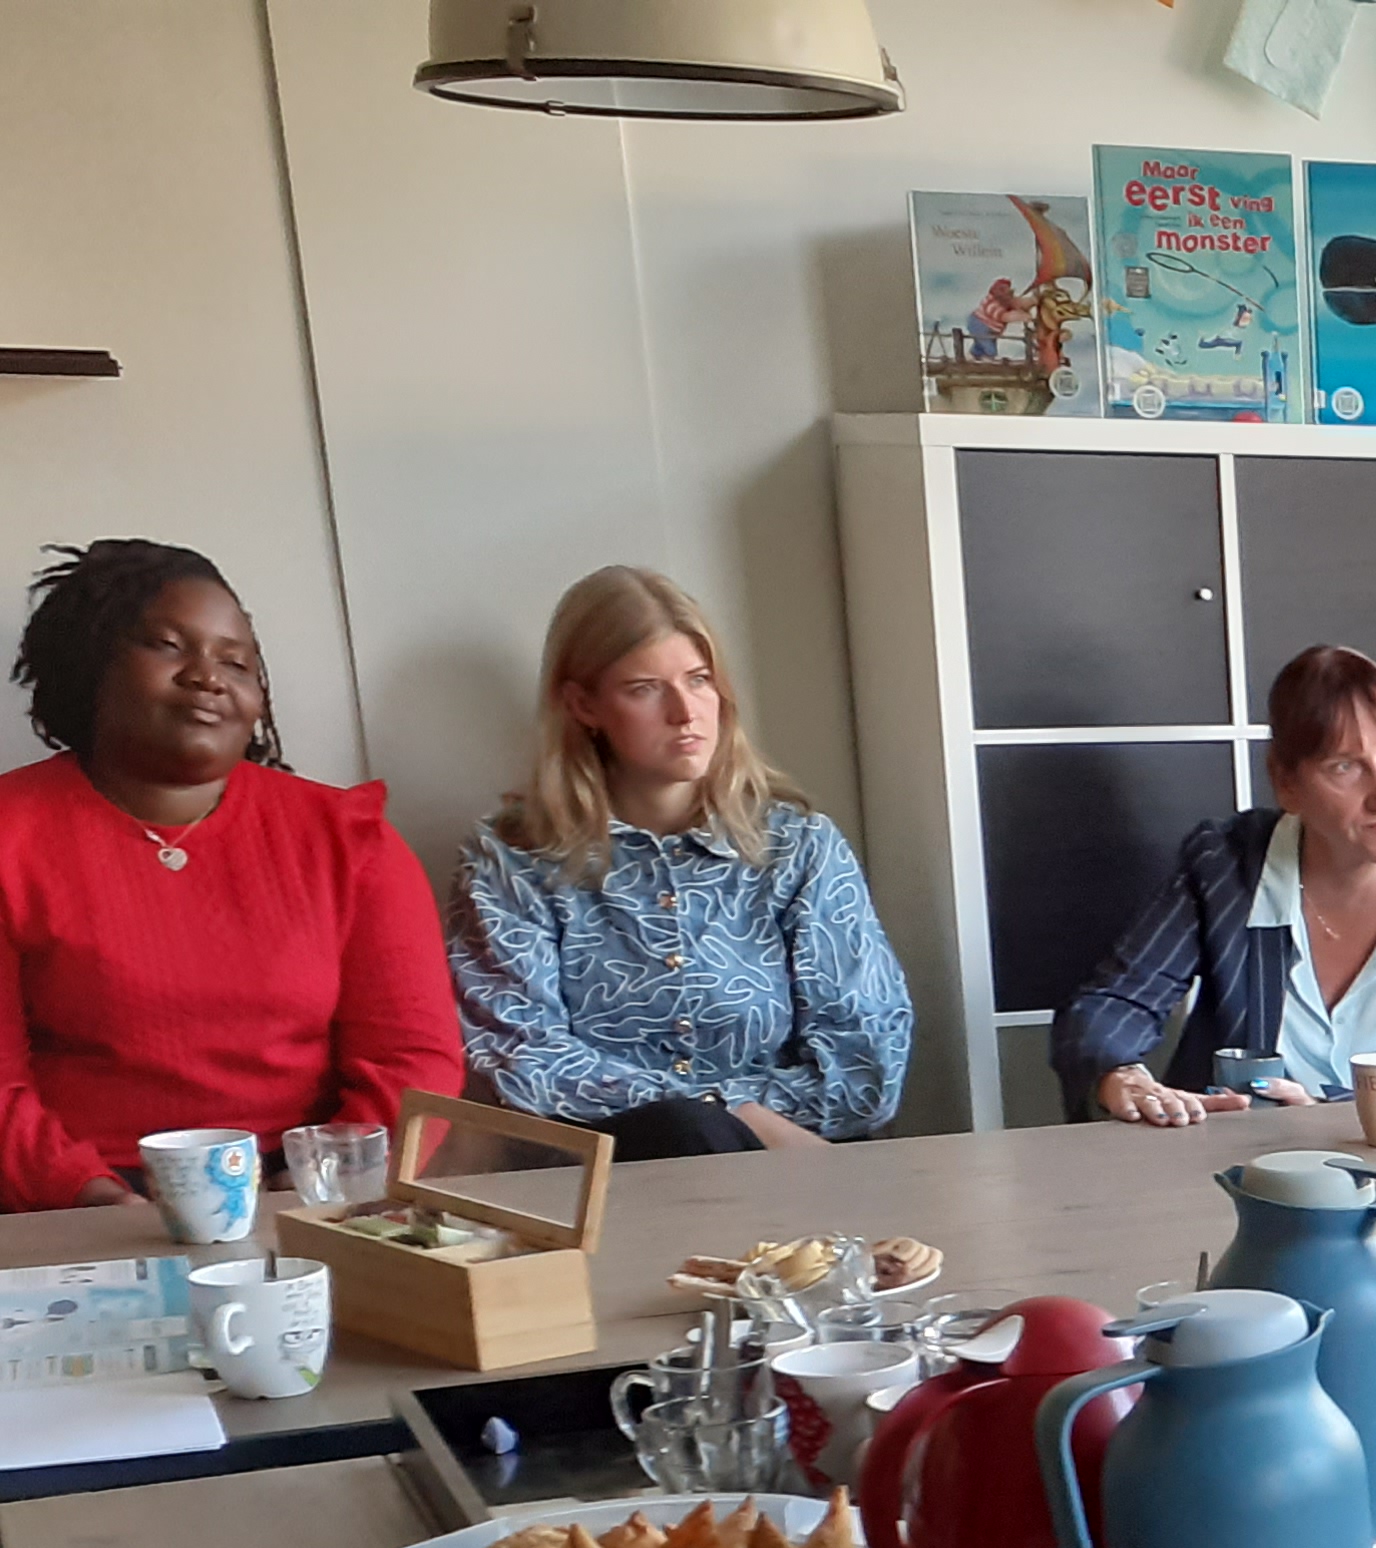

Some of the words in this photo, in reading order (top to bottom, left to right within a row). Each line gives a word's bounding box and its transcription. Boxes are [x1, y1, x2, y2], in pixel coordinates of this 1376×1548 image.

[1141, 160, 1199, 180] Maar
[1124, 180, 1221, 211] eerst
[1229, 194, 1274, 212] ving
[1187, 212, 1204, 228] ik
[1209, 213, 1246, 229] een
[1156, 230, 1272, 254] monster
